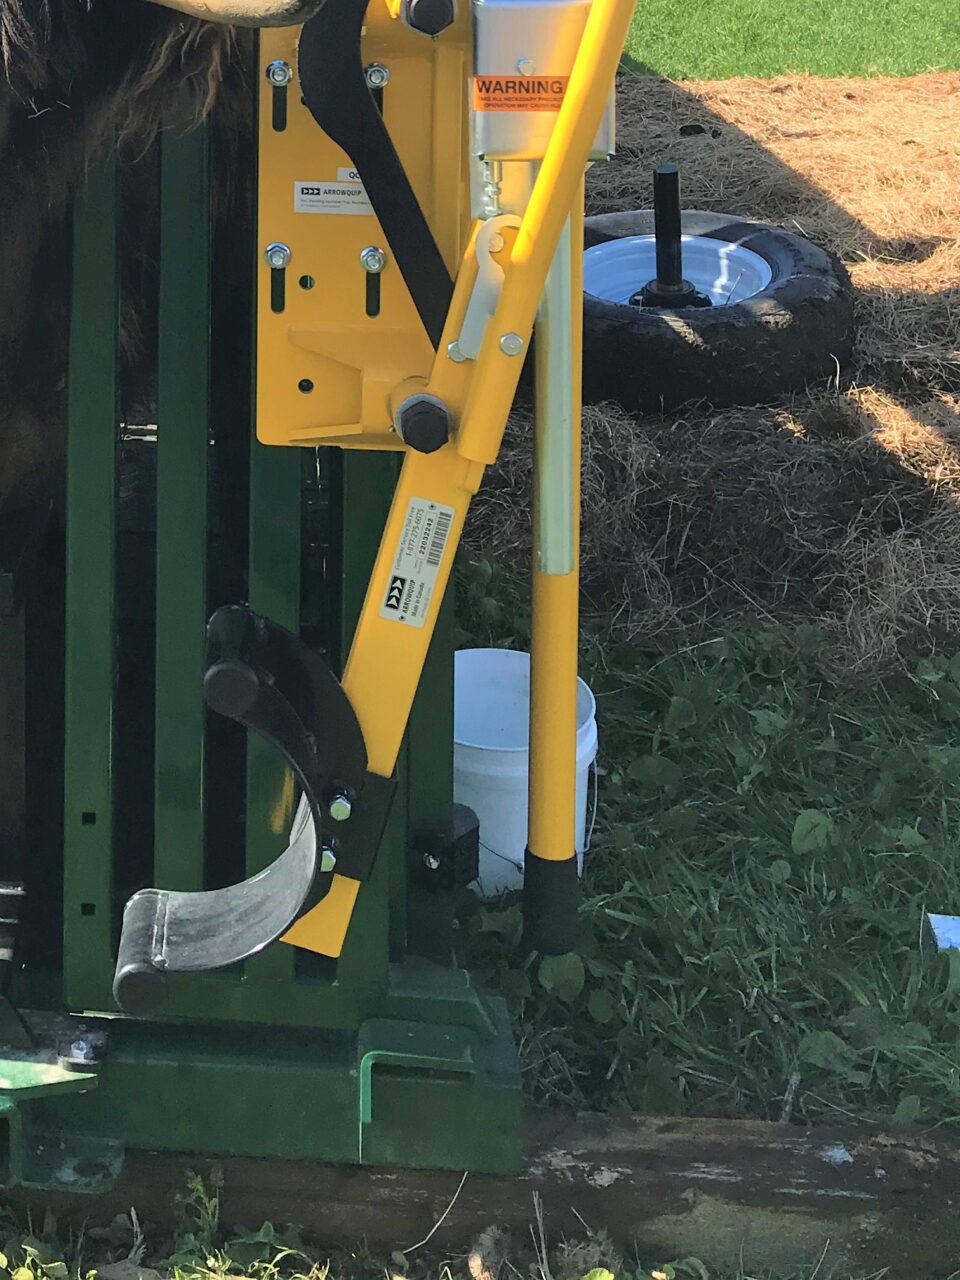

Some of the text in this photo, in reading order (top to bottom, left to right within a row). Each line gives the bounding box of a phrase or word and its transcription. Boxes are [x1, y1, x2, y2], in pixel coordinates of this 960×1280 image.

[418, 518, 434, 555] 22032242
[402, 579, 416, 614] ARROWQUIP
[416, 582, 425, 599] Canada
